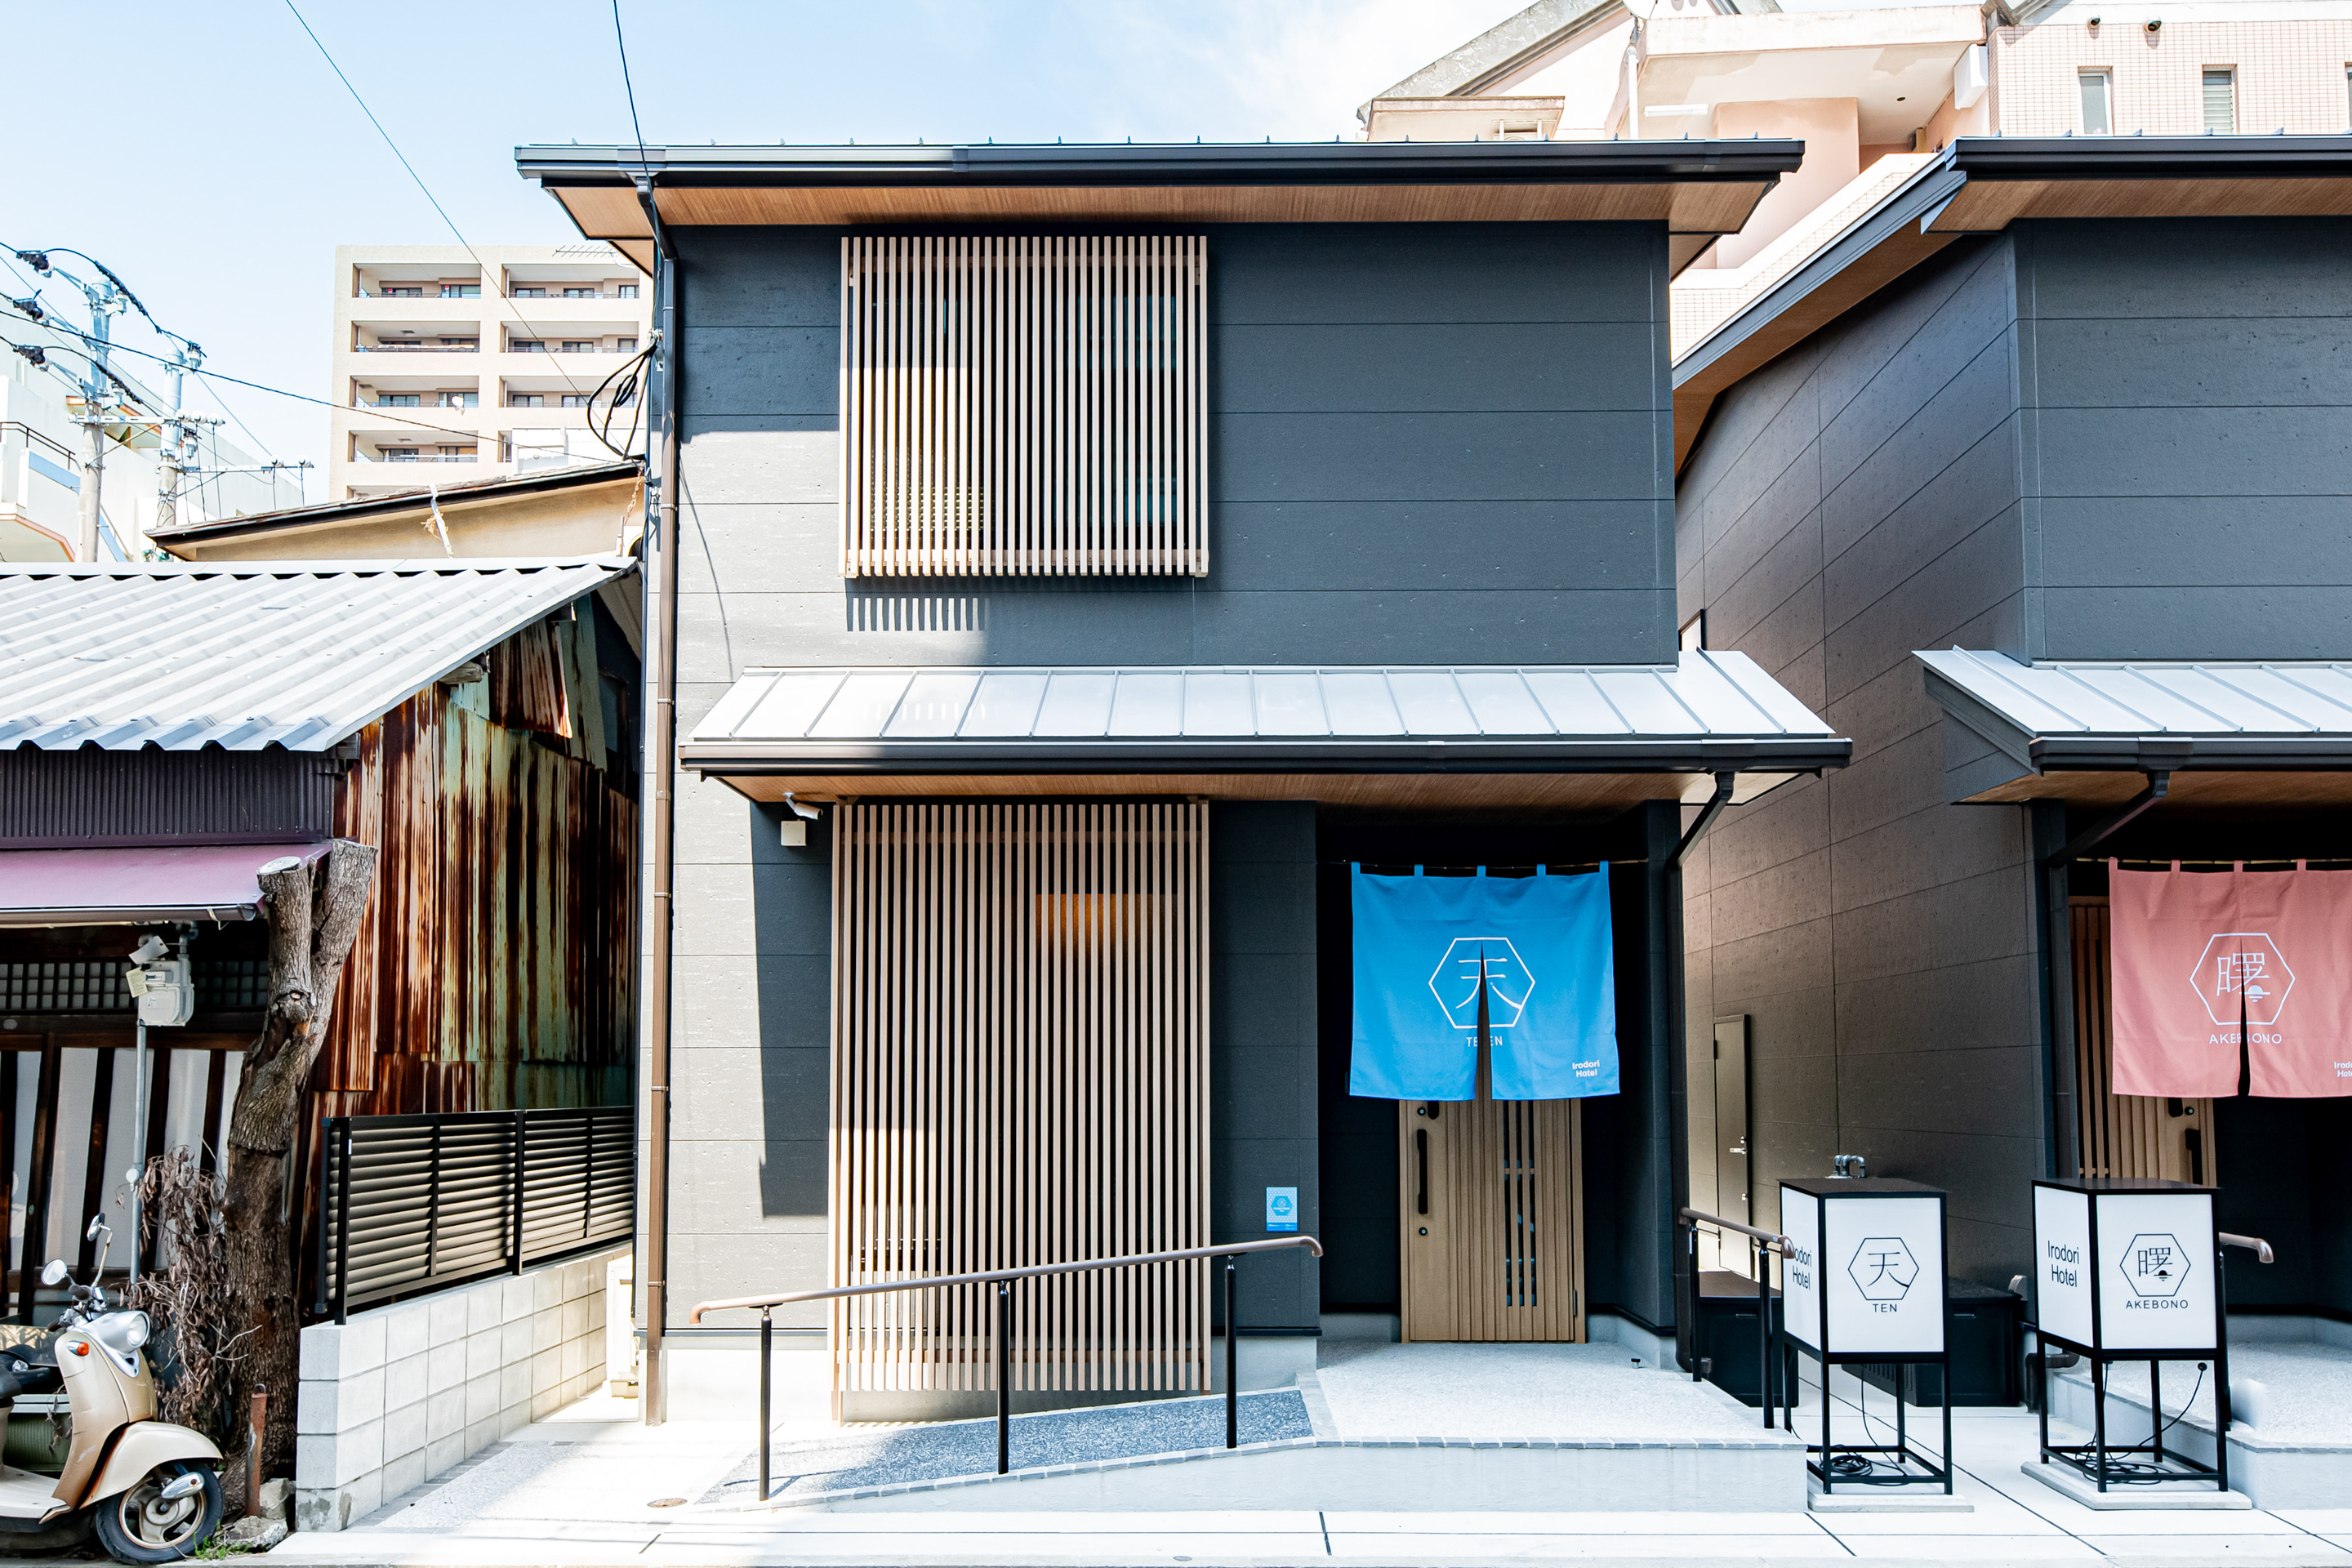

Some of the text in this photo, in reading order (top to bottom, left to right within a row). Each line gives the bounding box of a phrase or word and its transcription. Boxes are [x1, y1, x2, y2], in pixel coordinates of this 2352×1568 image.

[1455, 958, 1522, 1009] 天
[1572, 1059, 1601, 1070] Irodori
[2334, 1061, 2352, 1069] Irod
[1576, 1068, 1598, 1078] Hotel
[2337, 1069, 2352, 1078] Hot
[1793, 1245, 1812, 1267] odori
[2047, 1240, 2080, 1265] Irodori
[1793, 1265, 1811, 1290] Hotel
[1867, 1251, 1910, 1288] 天
[2051, 1264, 2078, 1288] Hotel
[1873, 1303, 1898, 1313] TEN
[2125, 1299, 2189, 1309] AKEBONO
